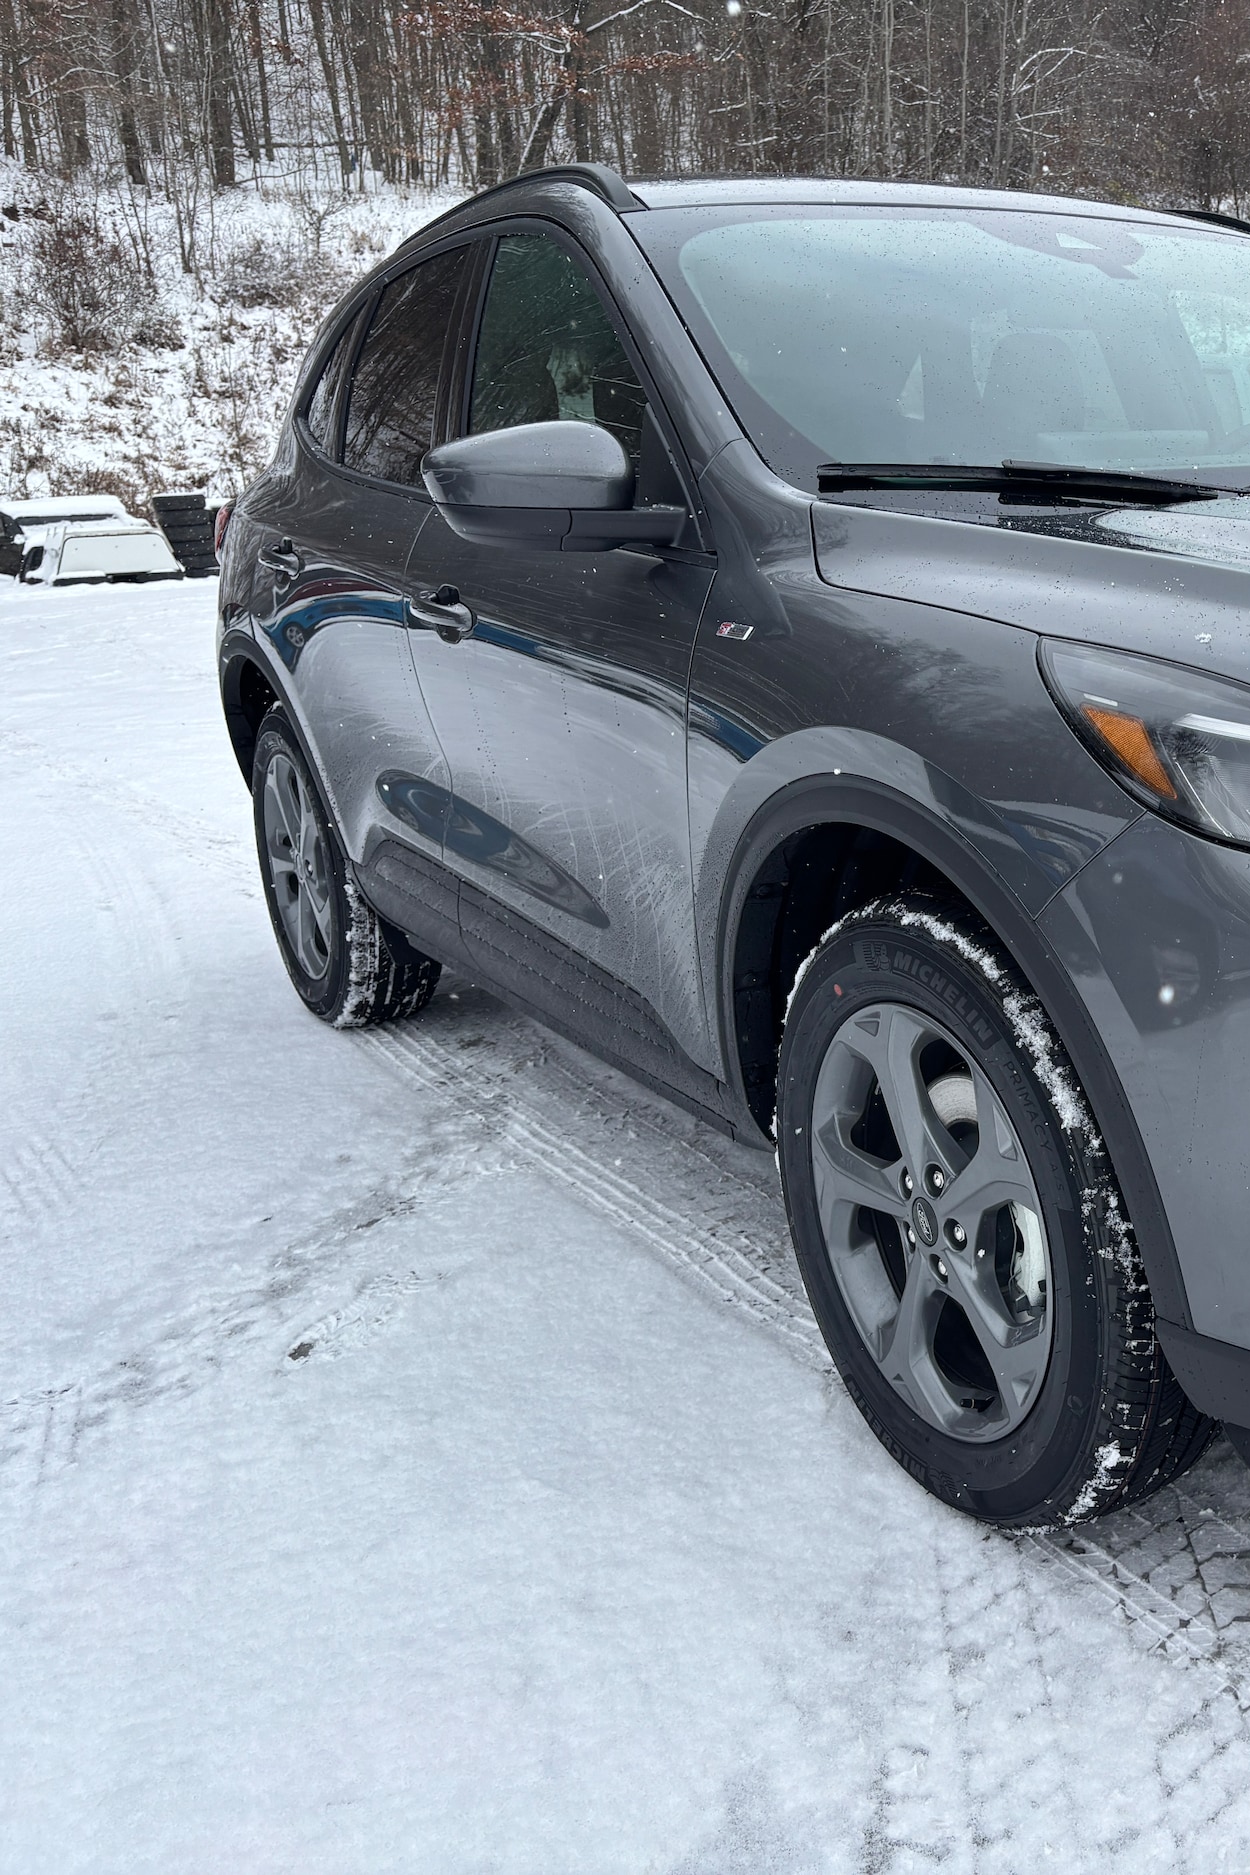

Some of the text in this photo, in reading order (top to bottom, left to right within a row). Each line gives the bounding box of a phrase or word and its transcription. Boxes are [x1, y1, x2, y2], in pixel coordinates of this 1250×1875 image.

[894, 951, 994, 1044] MICHELIN
[1002, 1061, 1055, 1153] PRIMACY
[846, 1379, 927, 1482] MICHELIN
